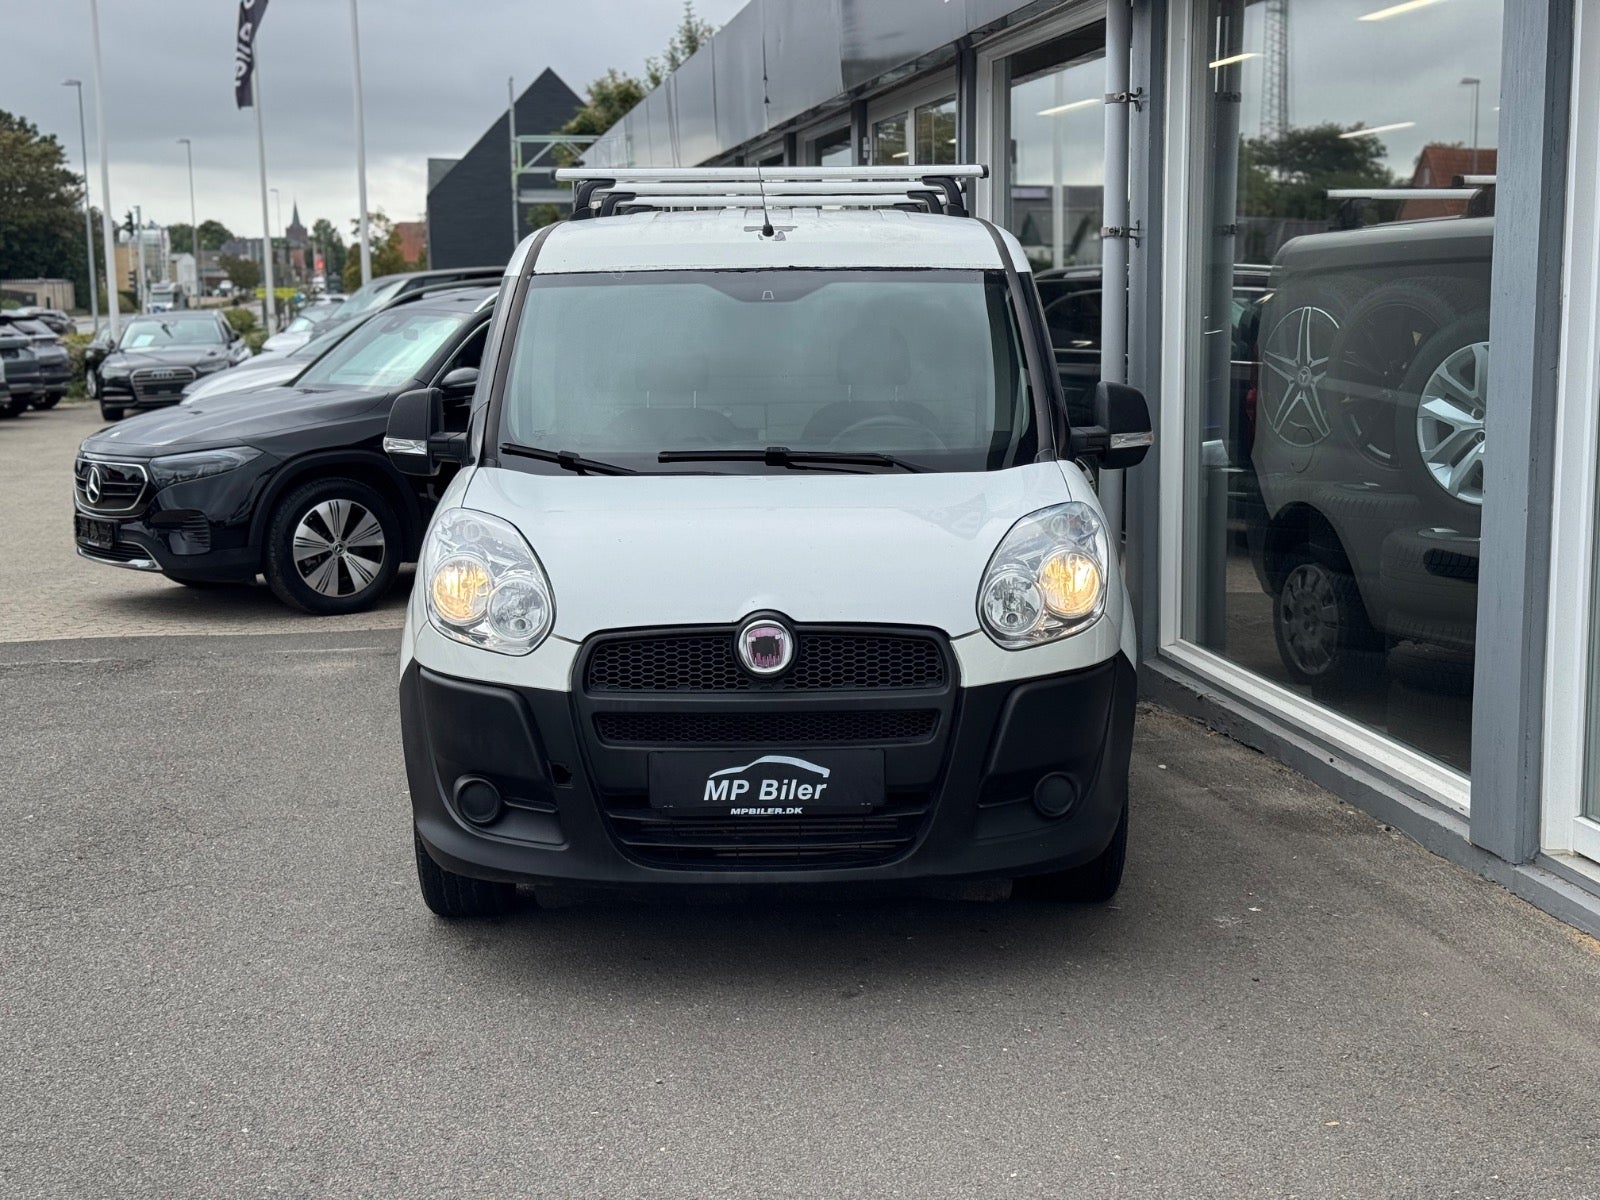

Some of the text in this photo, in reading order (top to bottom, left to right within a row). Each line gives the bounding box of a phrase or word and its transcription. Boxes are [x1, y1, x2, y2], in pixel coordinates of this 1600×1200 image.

[703, 778, 828, 801] MP Biler
[730, 807, 803, 815] MPBILER.DK
